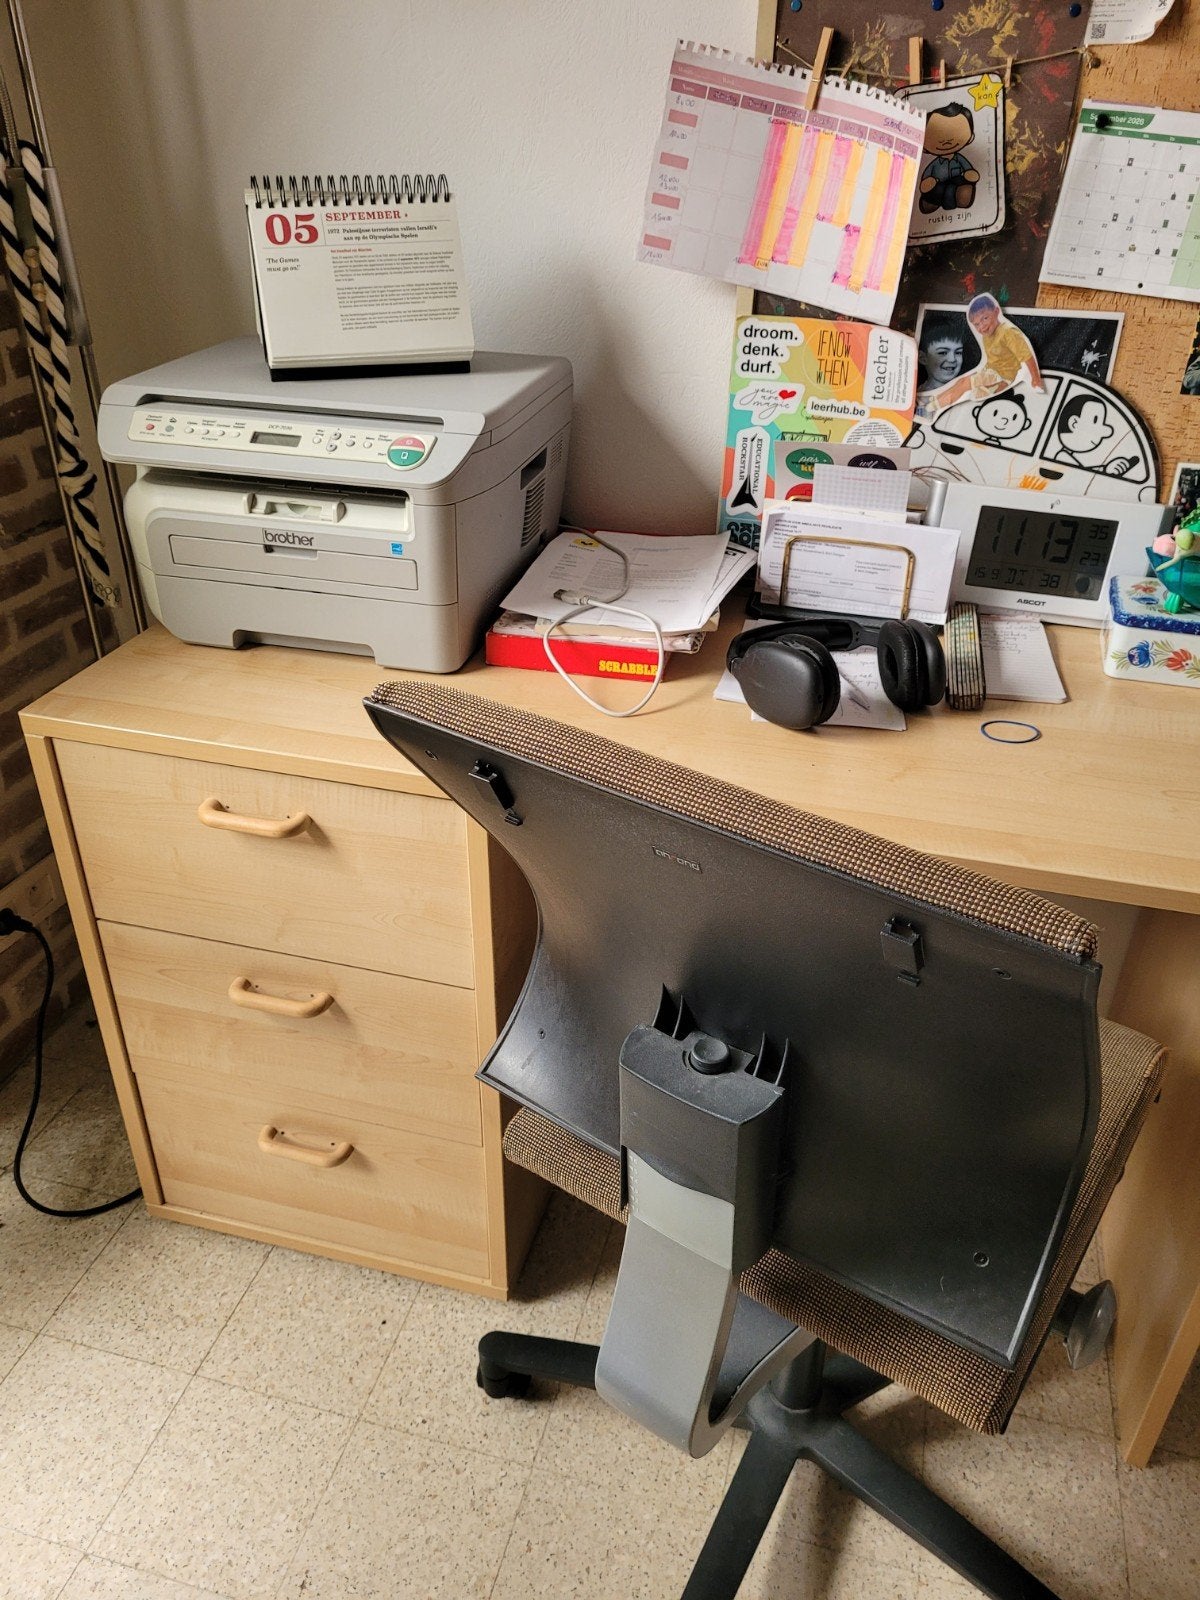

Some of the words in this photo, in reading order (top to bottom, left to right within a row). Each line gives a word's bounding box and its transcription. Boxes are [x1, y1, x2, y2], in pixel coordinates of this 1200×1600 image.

[325, 210, 401, 222] SEPTEMBER
[928, 215, 952, 224] rustig
[957, 213, 972, 221] zijn
[265, 213, 319, 246] 05
[743, 324, 798, 341] droom.
[742, 344, 784, 358] denk.
[740, 360, 776, 374] durf.
[872, 336, 889, 401] teacher
[811, 401, 866, 416] leerhub.be
[739, 437, 748, 480] ROCKSTAR
[752, 438, 763, 493] EDUCATIONAL
[264, 530, 315, 546] brother
[1088, 524, 1109, 540] 35
[1039, 573, 1061, 588] 38
[1017, 598, 1046, 607] ASCOT
[599, 660, 659, 676] SCRABBLE
